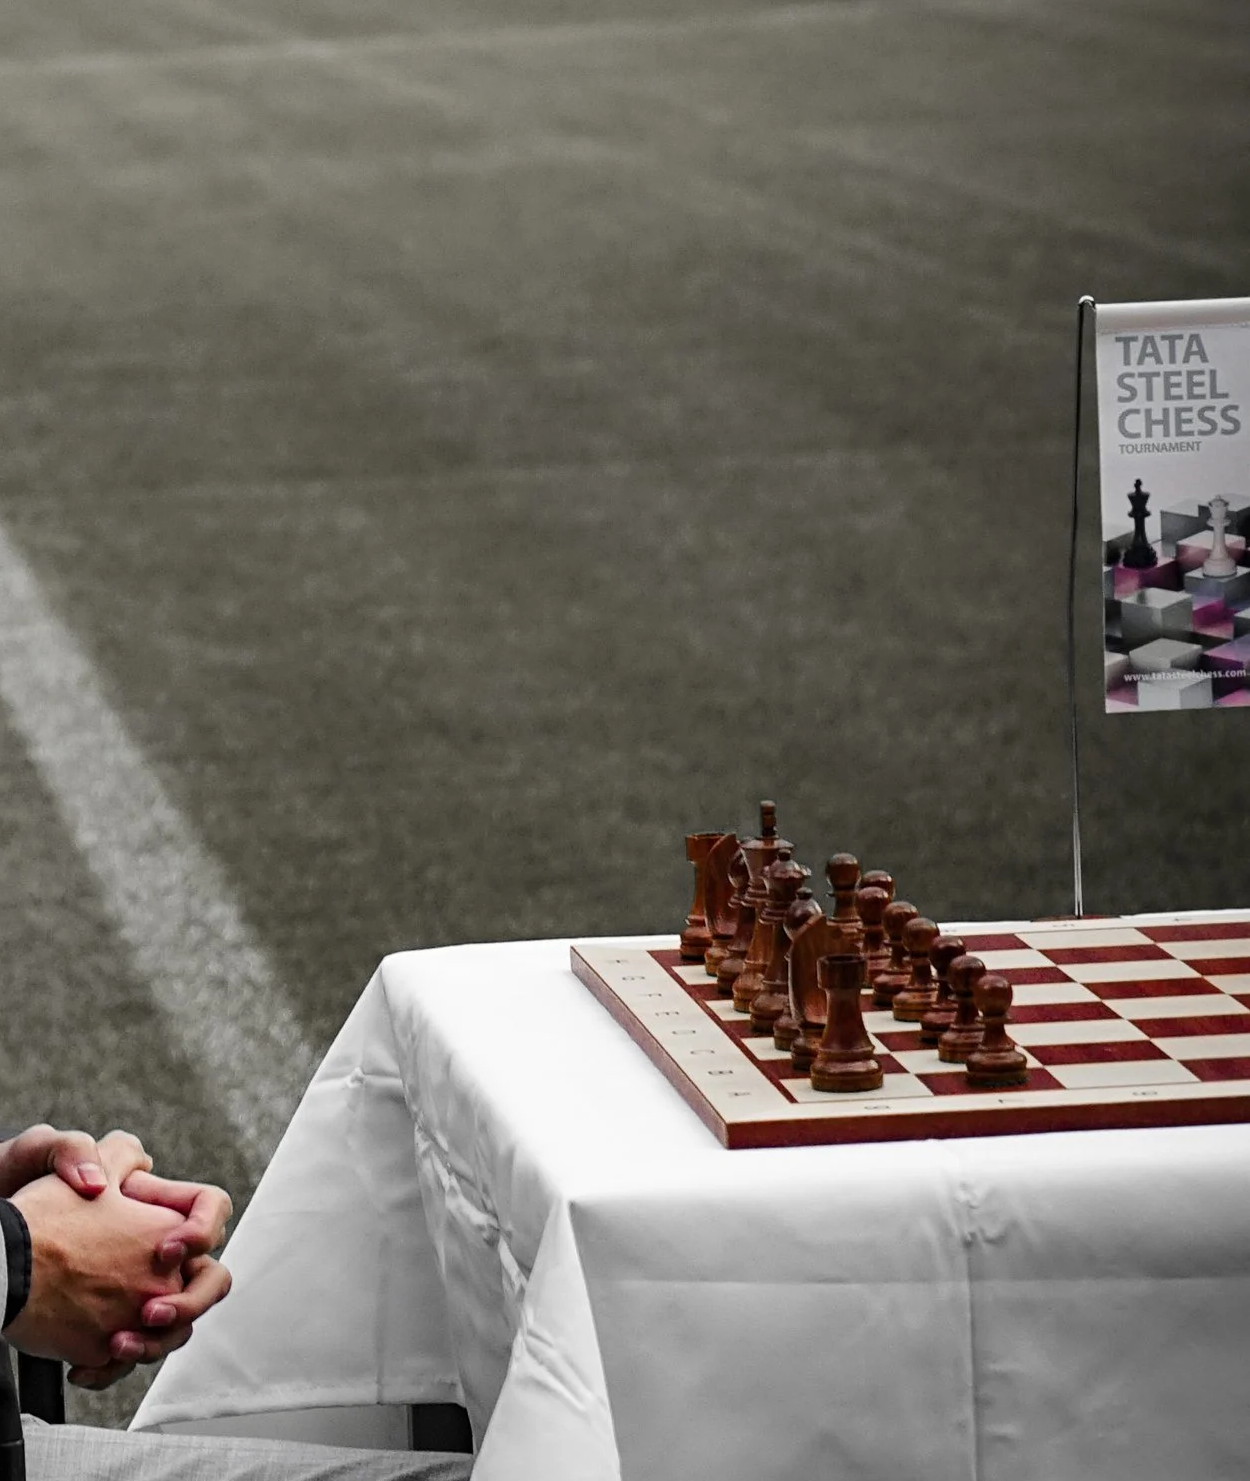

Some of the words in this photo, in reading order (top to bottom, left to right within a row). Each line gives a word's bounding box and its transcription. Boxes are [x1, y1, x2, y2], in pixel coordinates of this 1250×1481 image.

[1114, 333, 1210, 367] TATA
[1116, 369, 1230, 403] STEEL
[1117, 404, 1241, 440] CHESS
[1118, 440, 1202, 454] TOURNAMENT
